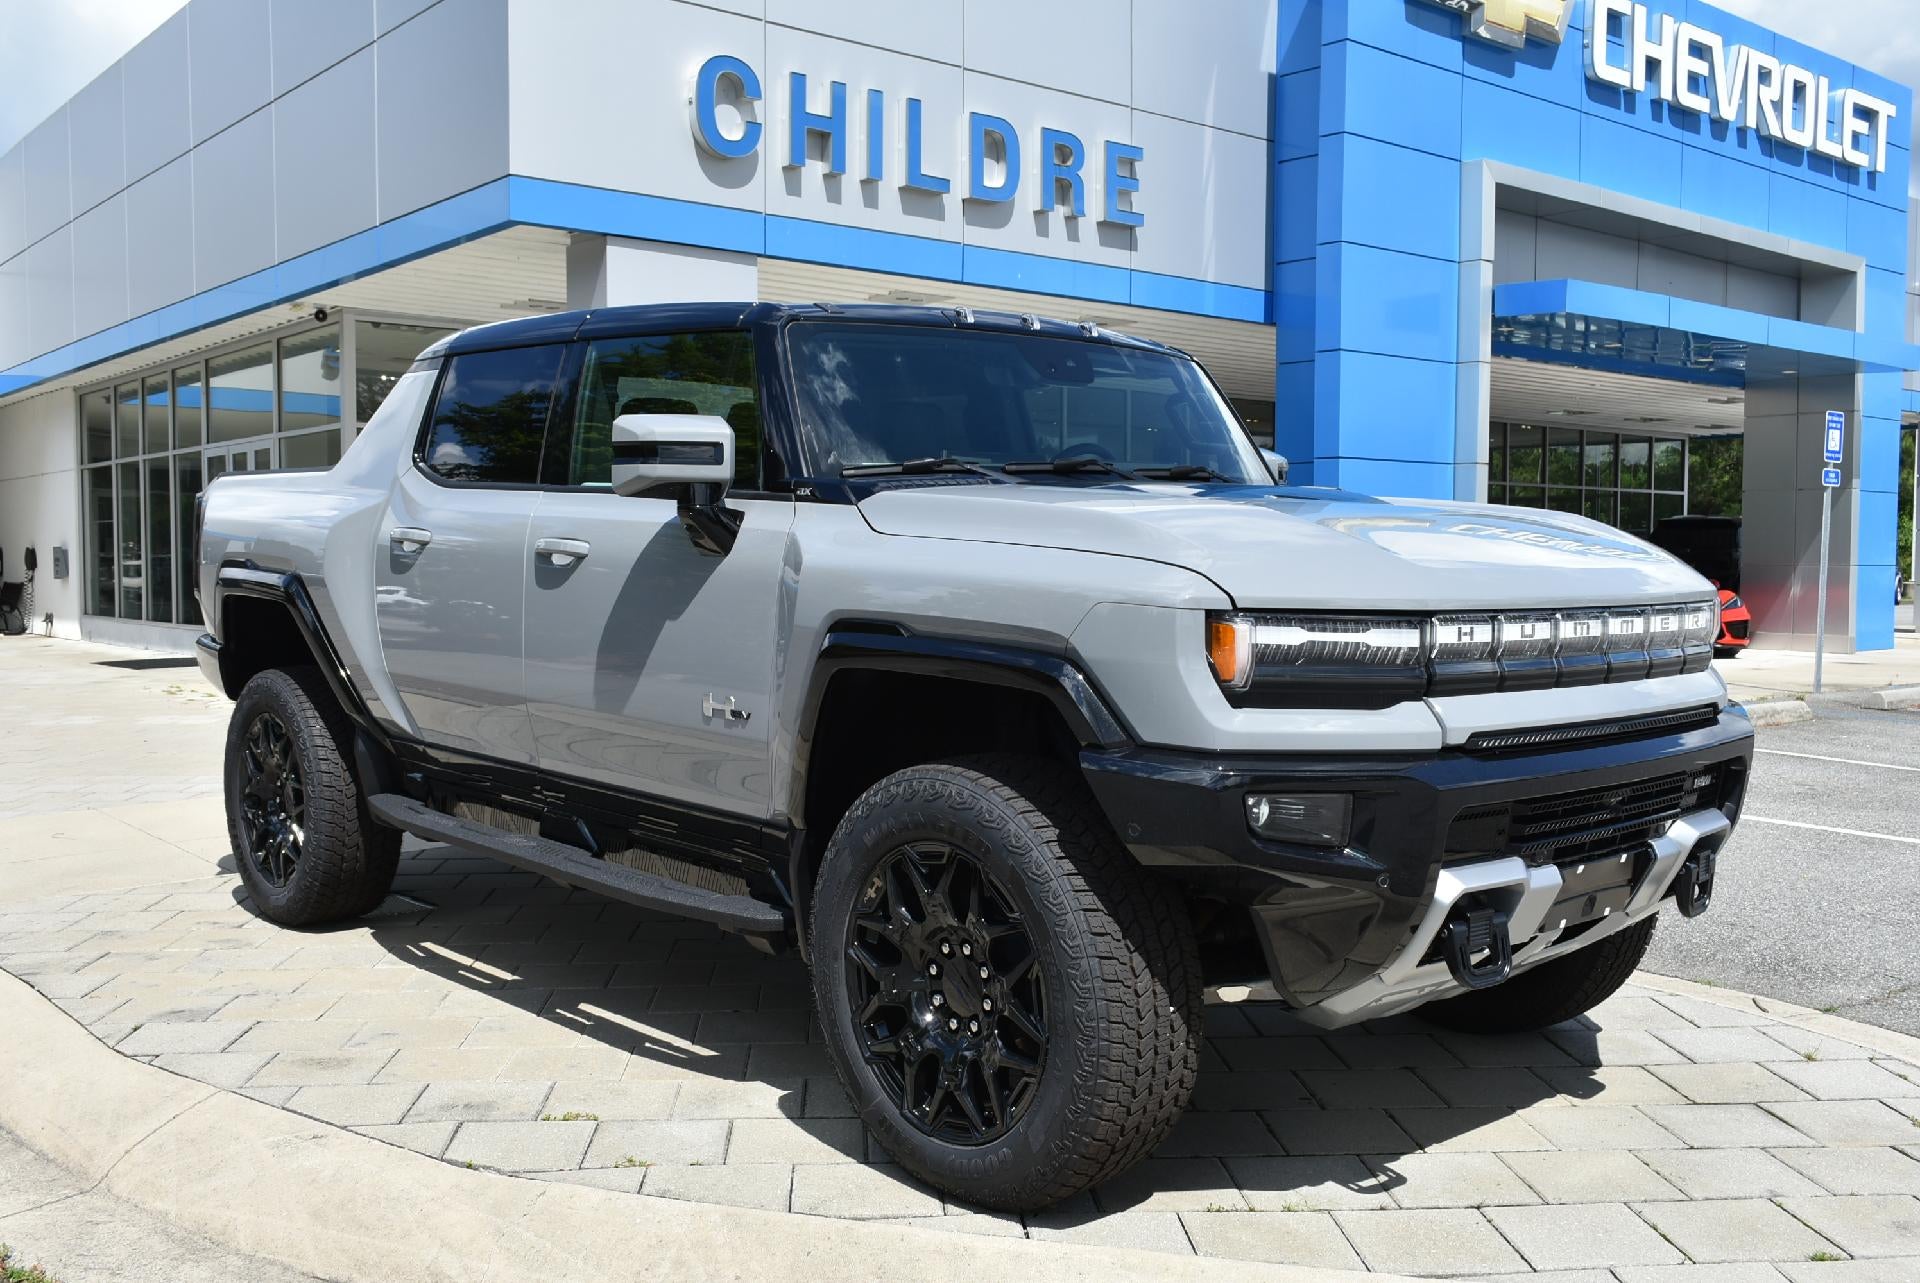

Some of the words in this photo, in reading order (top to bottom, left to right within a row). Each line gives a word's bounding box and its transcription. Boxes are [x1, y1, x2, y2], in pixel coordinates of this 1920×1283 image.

[693, 54, 1145, 229] CHILDRE
[1586, 0, 1897, 173] CHEVROLET
[1457, 614, 1701, 643] HUMMER
